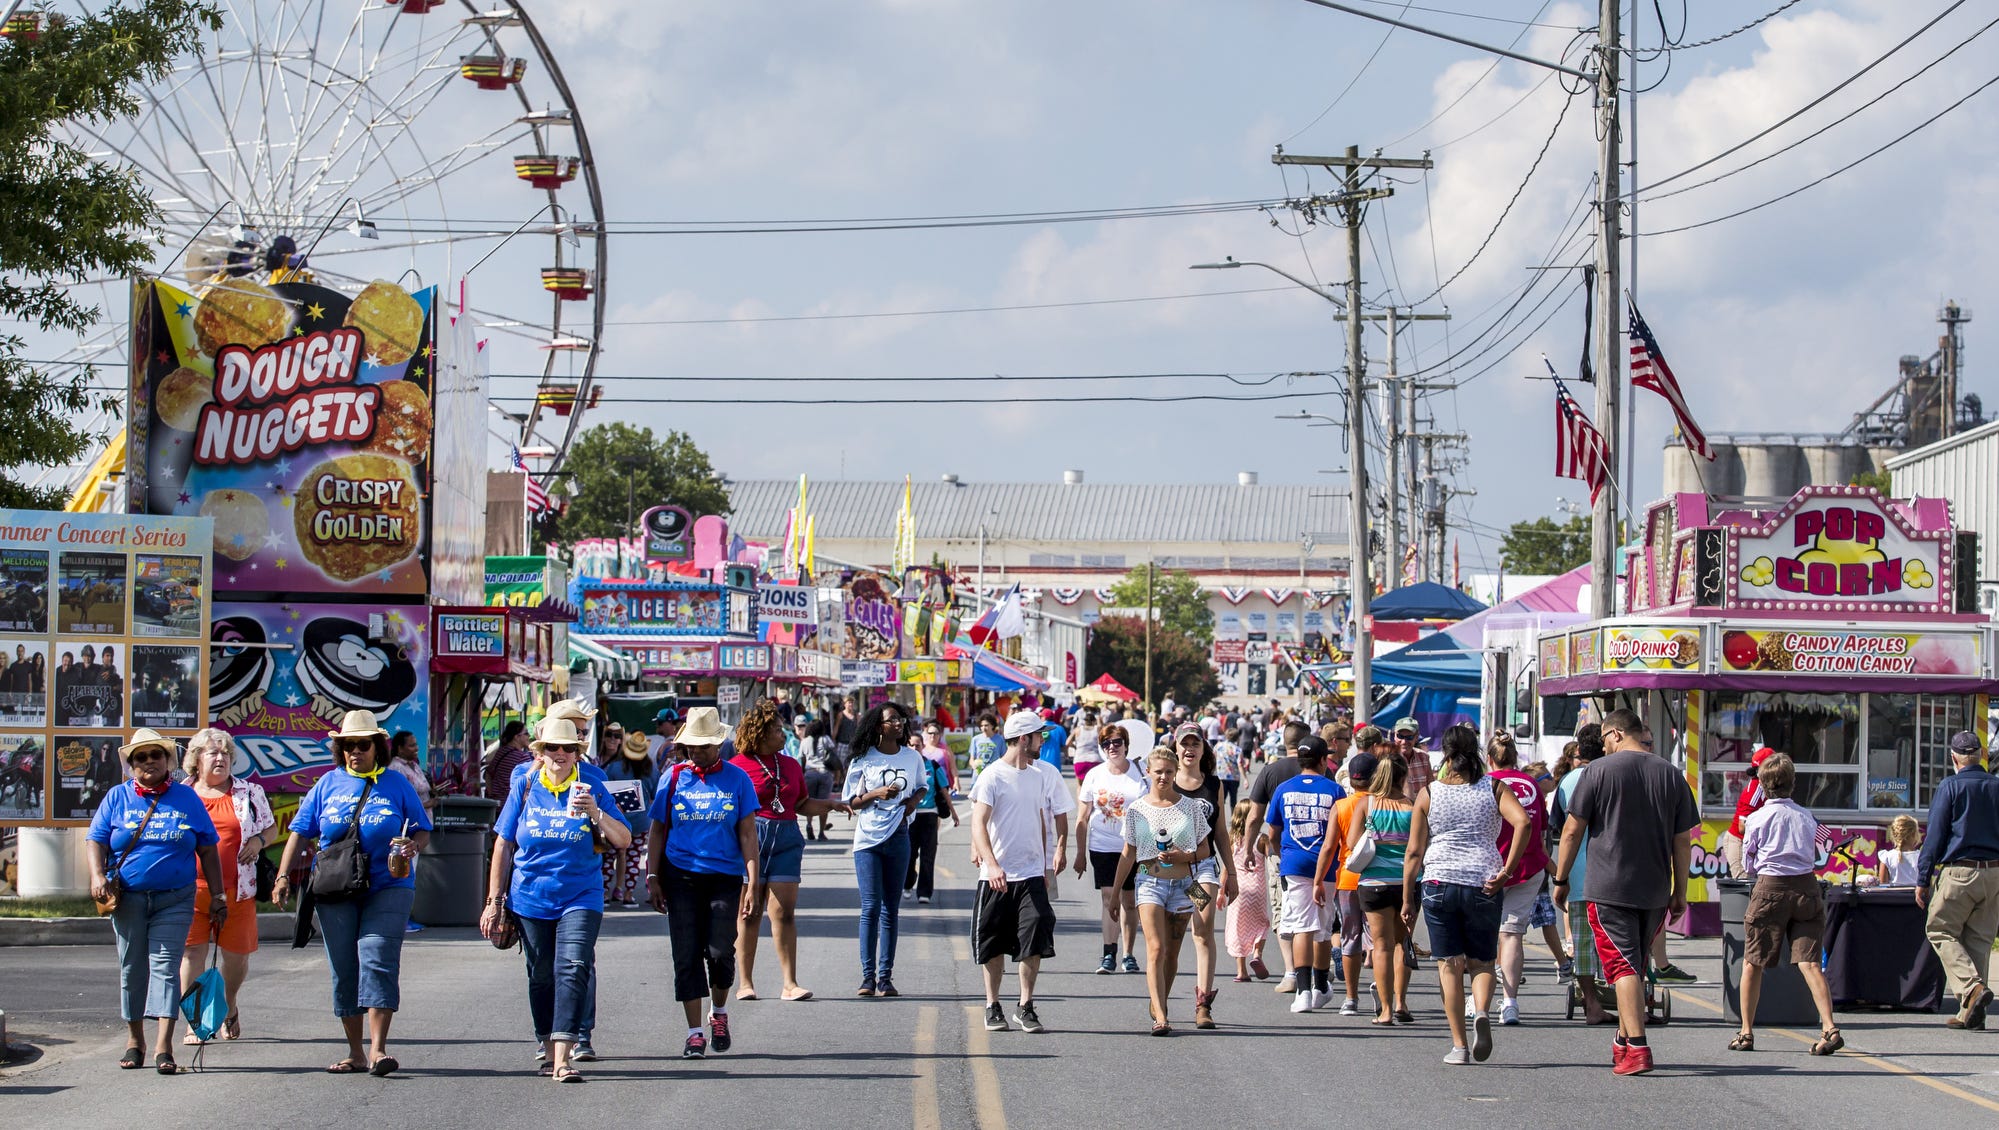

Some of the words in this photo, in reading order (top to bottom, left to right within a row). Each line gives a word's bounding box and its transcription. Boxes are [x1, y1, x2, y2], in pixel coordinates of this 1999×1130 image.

[220, 334, 357, 402] DOUGH
[199, 391, 376, 459] NUGGETS
[317, 475, 403, 506] CRISPY
[57, 522, 126, 544] Concert
[132, 525, 186, 547] Series
[314, 513, 402, 541] GOLDEN
[1794, 506, 1886, 548] POP
[498, 572, 538, 584] COLADA
[1775, 556, 1902, 596] CORN
[631, 599, 677, 618] ICEE
[445, 618, 499, 631] Bottled
[449, 632, 493, 652] Water
[1609, 640, 1629, 656] COLD
[1632, 639, 1678, 656] DRINKS
[1784, 633, 1840, 650] CANDY
[1843, 634, 1905, 652] APPLES
[636, 650, 670, 662] CEE
[725, 649, 765, 666] ICEE
[1793, 653, 1858, 671] COTTON
[1860, 654, 1914, 672] CANDY
[247, 706, 286, 734] Deep
[290, 712, 332, 731] Fried
[232, 738, 334, 776] RE
[550, 819, 566, 828] Fair
[1689, 844, 1733, 876] Cot
